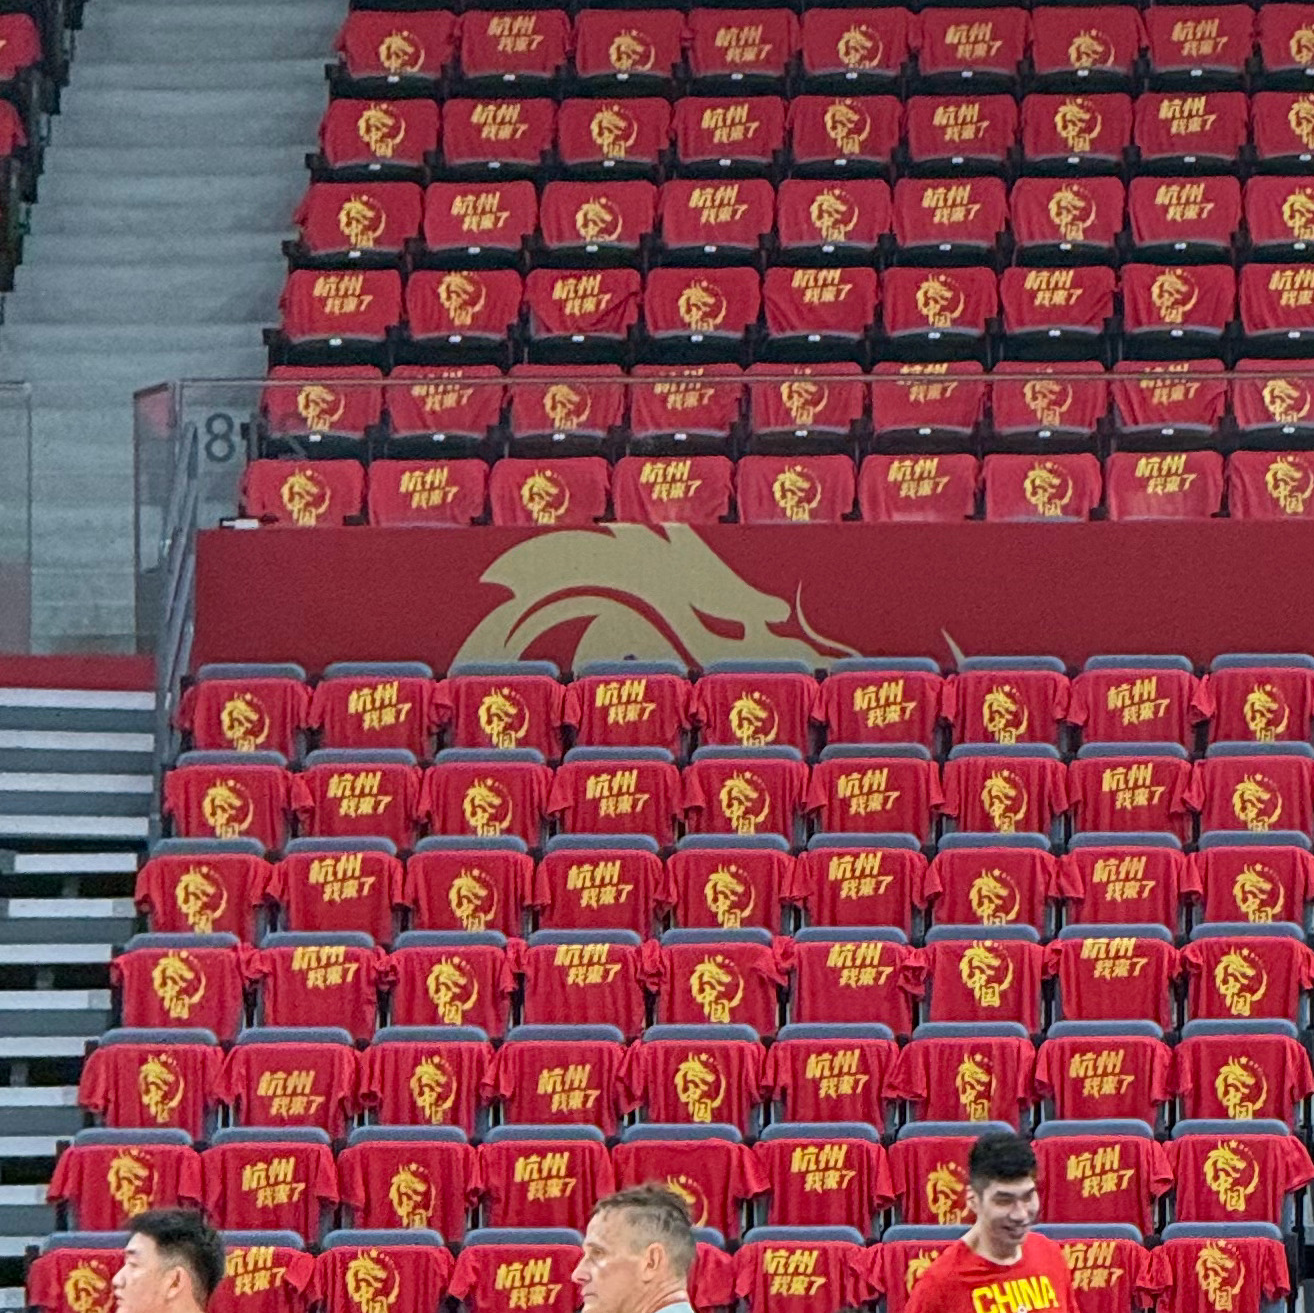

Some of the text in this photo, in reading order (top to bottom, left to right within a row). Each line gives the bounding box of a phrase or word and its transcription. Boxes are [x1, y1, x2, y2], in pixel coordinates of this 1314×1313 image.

[348, 682, 398, 713] 杭州
[596, 680, 646, 707] 杭州
[854, 680, 903, 710] 杭州
[1108, 677, 1156, 709] 杭州
[328, 772, 381, 797] 杭州
[586, 770, 637, 798] 杭州
[838, 768, 888, 798] 杭州
[1102, 764, 1152, 792] 杭州
[309, 854, 362, 883] 杭州
[568, 860, 620, 889] 杭州
[829, 851, 882, 880] 杭州
[1093, 856, 1146, 882] 杭州
[292, 946, 347, 970] 杭州
[554, 943, 610, 966] 杭州
[828, 942, 882, 967] 杭州
[806, 1050, 860, 1079] 杭州
[1069, 1050, 1124, 1078] 杭州
[258, 1071, 314, 1096] 杭州
[538, 1064, 590, 1094] 杭州
[514, 1152, 569, 1182] 杭州
[791, 1144, 847, 1173] 杭州
[1067, 1145, 1120, 1180] 杭州
[242, 1157, 295, 1190] 杭州
[496, 1258, 552, 1289] 杭州
[764, 1249, 818, 1274] 杭州
